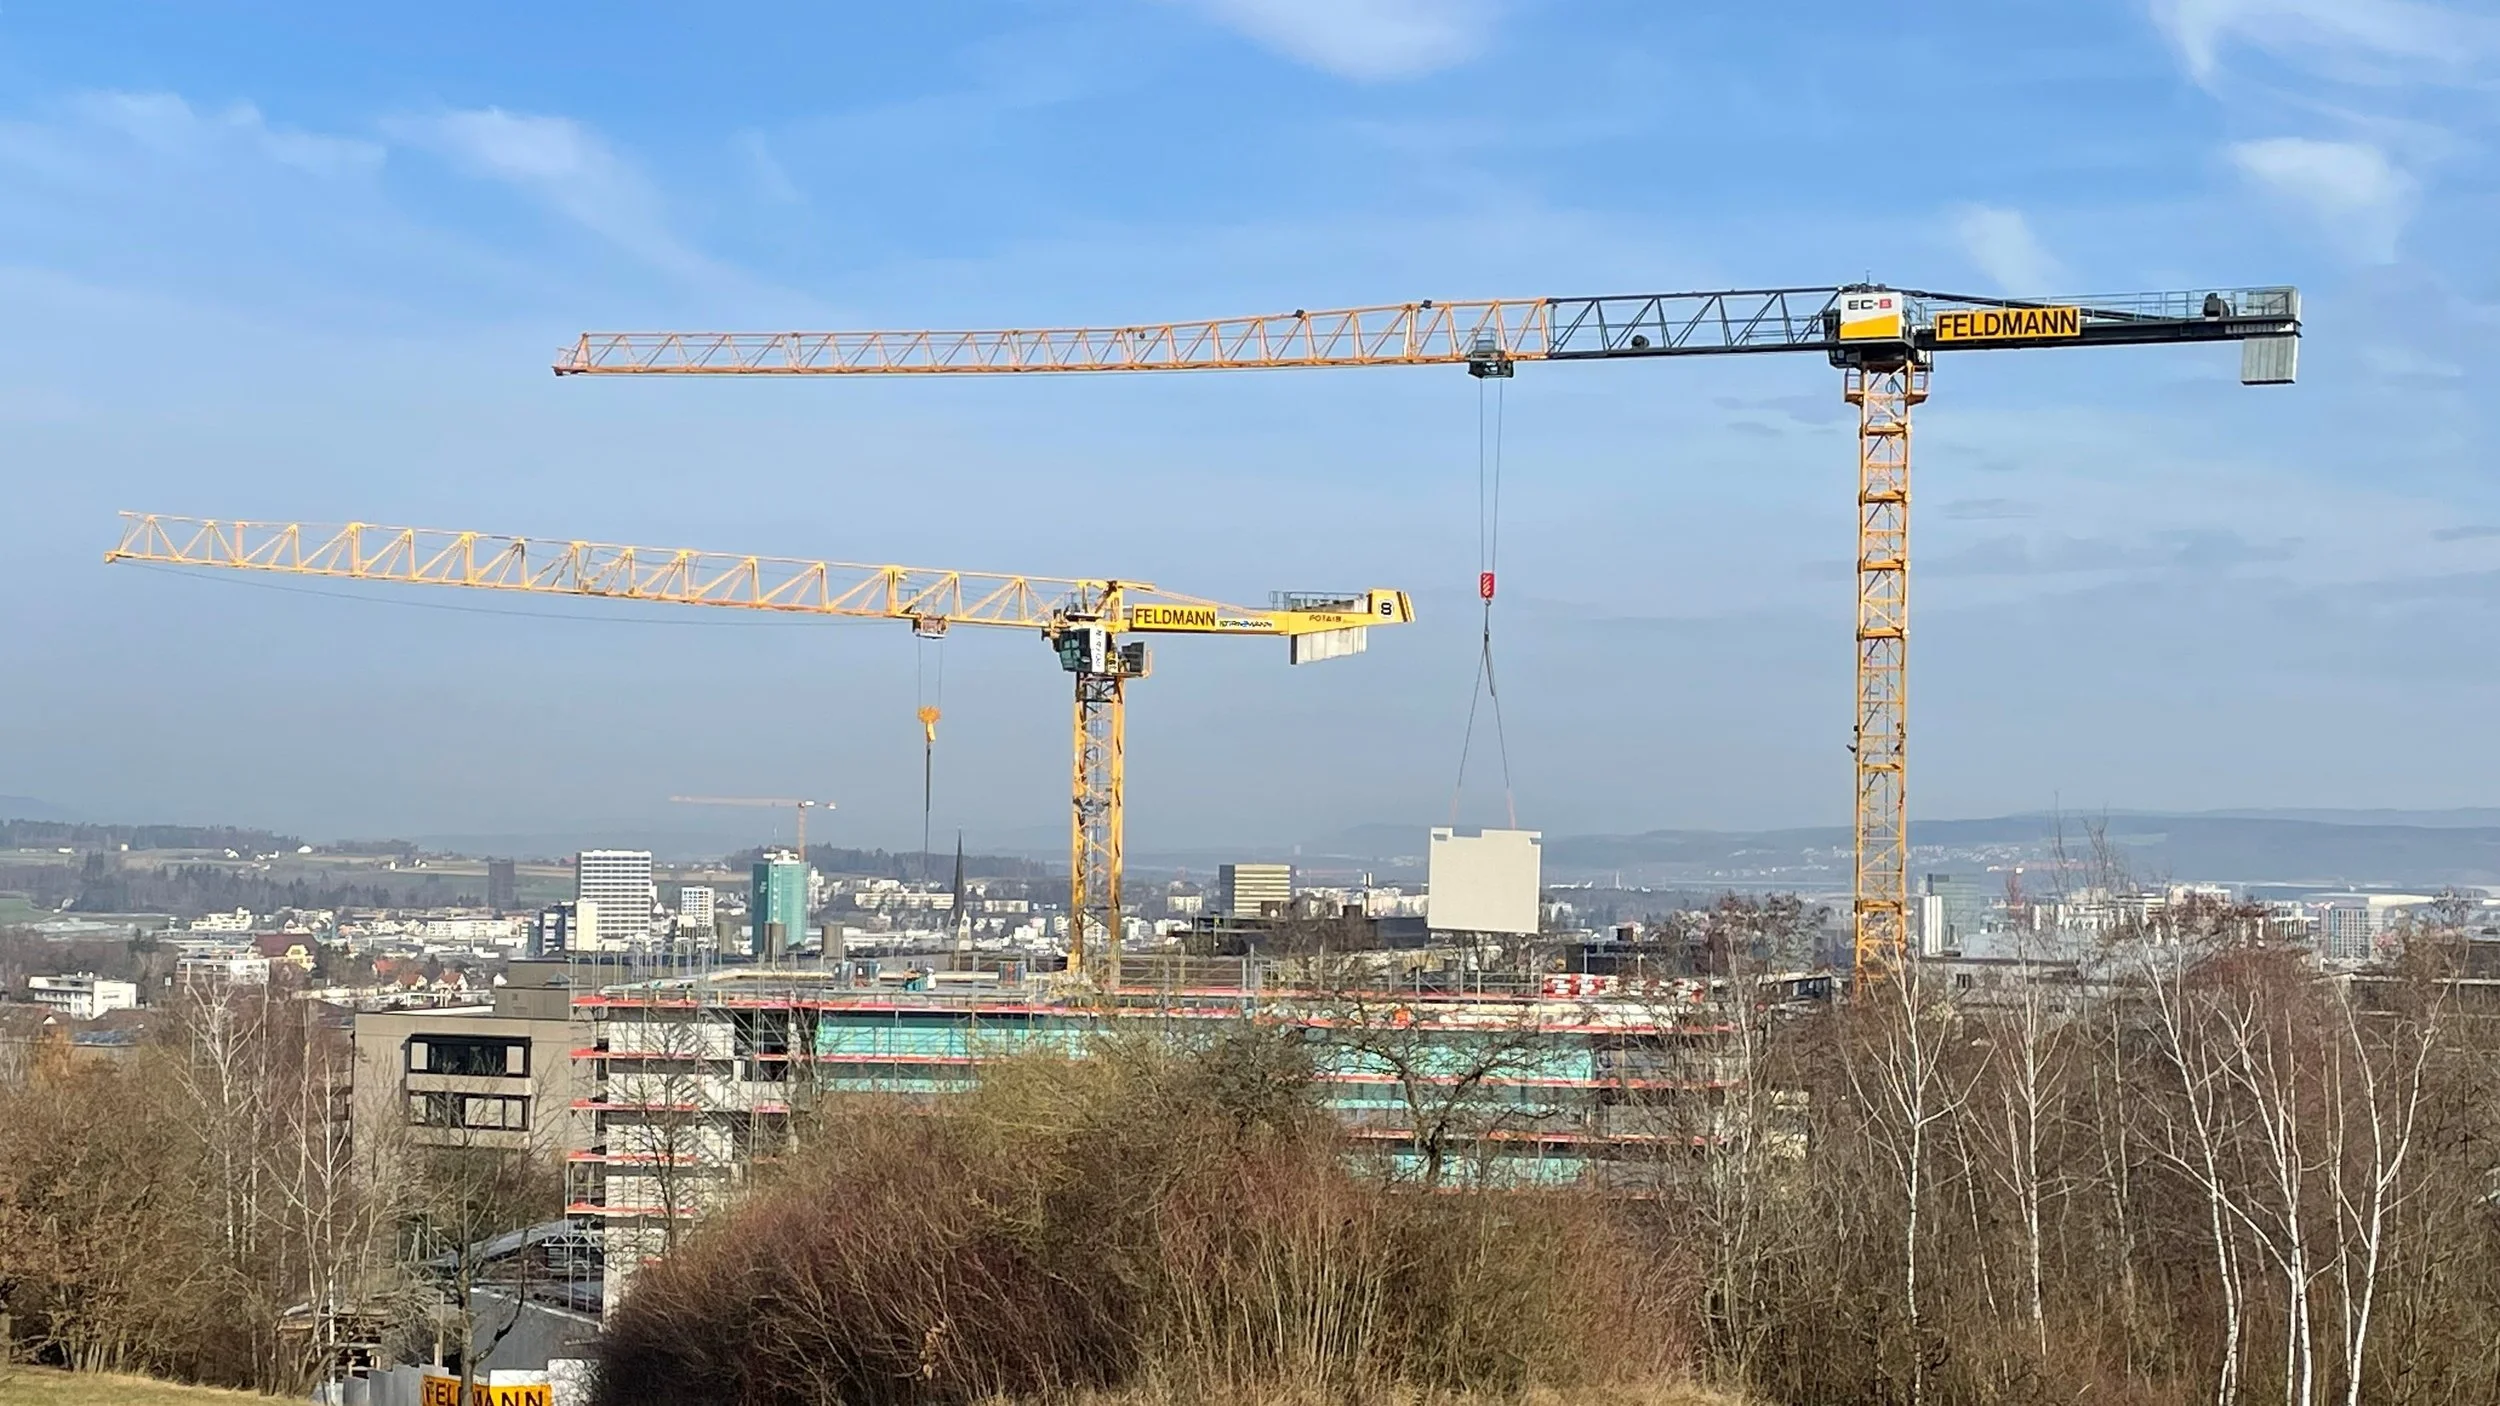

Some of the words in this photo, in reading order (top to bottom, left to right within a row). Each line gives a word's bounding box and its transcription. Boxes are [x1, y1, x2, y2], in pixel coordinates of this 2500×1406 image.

[1848, 298, 1892, 310] EC-B
[1937, 309, 2078, 338] FELDMANN
[1135, 607, 1216, 627] FELDMANN
[1380, 602, 1393, 616] 8
